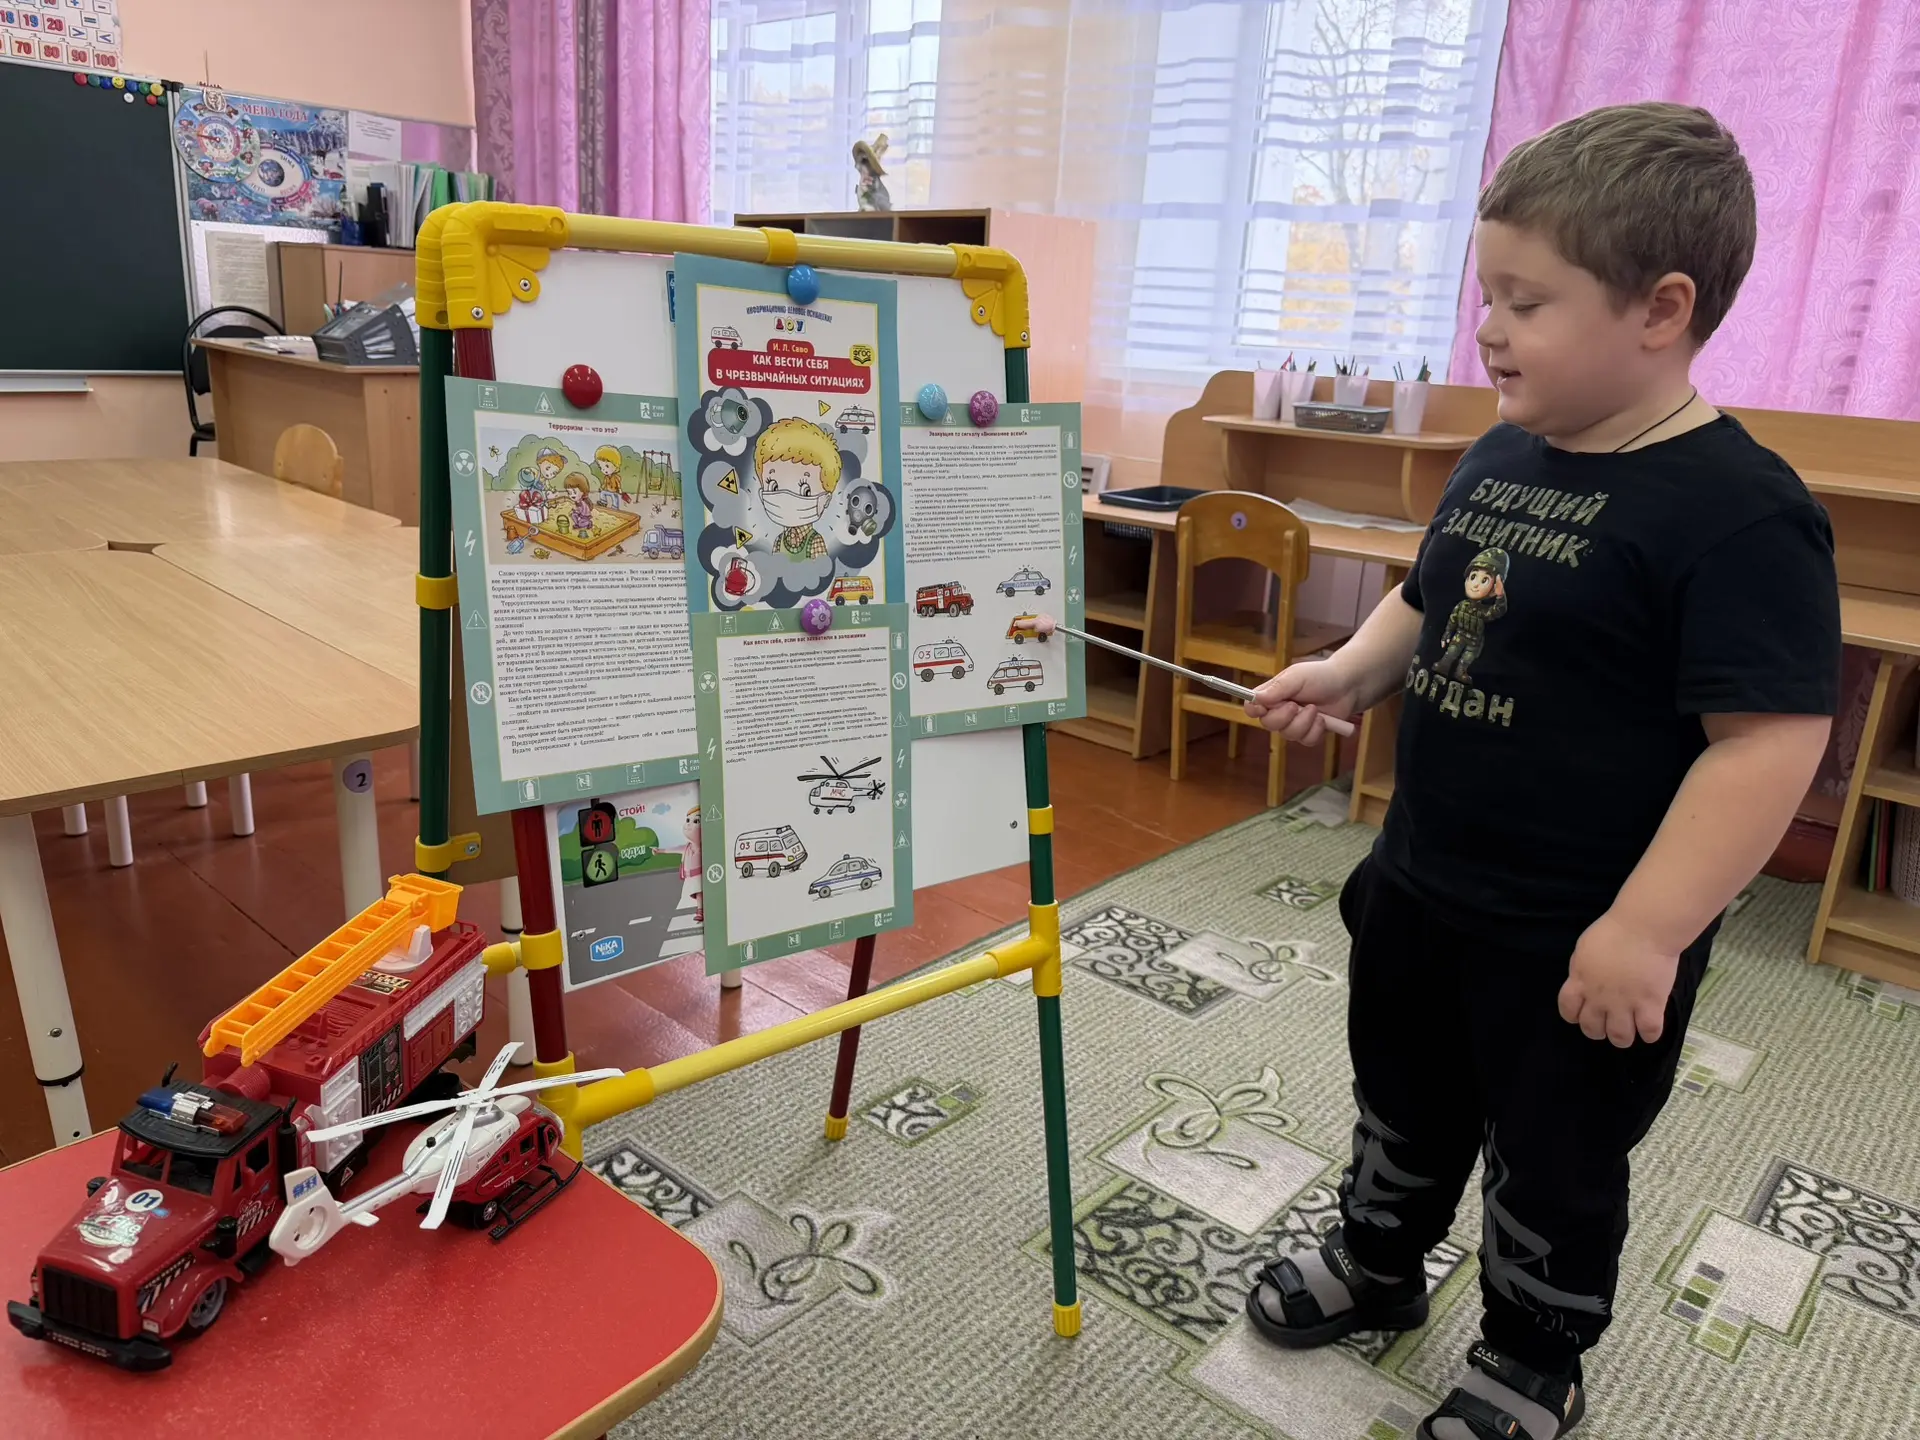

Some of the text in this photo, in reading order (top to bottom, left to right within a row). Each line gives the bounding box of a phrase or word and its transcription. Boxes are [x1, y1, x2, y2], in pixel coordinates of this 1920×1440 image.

[0, 10, 63, 31] 18 19 20
[15, 40, 116, 67] 70 80 90 100
[280, 107, 307, 121] ГОДА
[776, 318, 803, 331] ДОУ
[773, 343, 808, 353] И. Л. Саво
[753, 354, 829, 370] КАК ВЕСТИ СЕБЯ
[716, 369, 865, 388] В ЧРЕЗВЫЧАЙНЫХ СИТУАЦИЯХ
[549, 423, 583, 432] Терроризм
[1469, 478, 1610, 526] БУДУЩИЙ
[1442, 508, 1590, 568] ЗАЩИТНИК
[918, 651, 931, 659] 03
[356, 772, 368, 787] 2
[830, 789, 846, 797] МЧС
[619, 804, 645, 817] СТОЙ!
[621, 845, 646, 859] ИДИ!
[740, 842, 750, 850] 03
[792, 845, 800, 854] 03
[132, 1192, 160, 1208] 01
[1338, 1248, 1354, 1270] PLAY
[1477, 1346, 1499, 1361] PLAY
